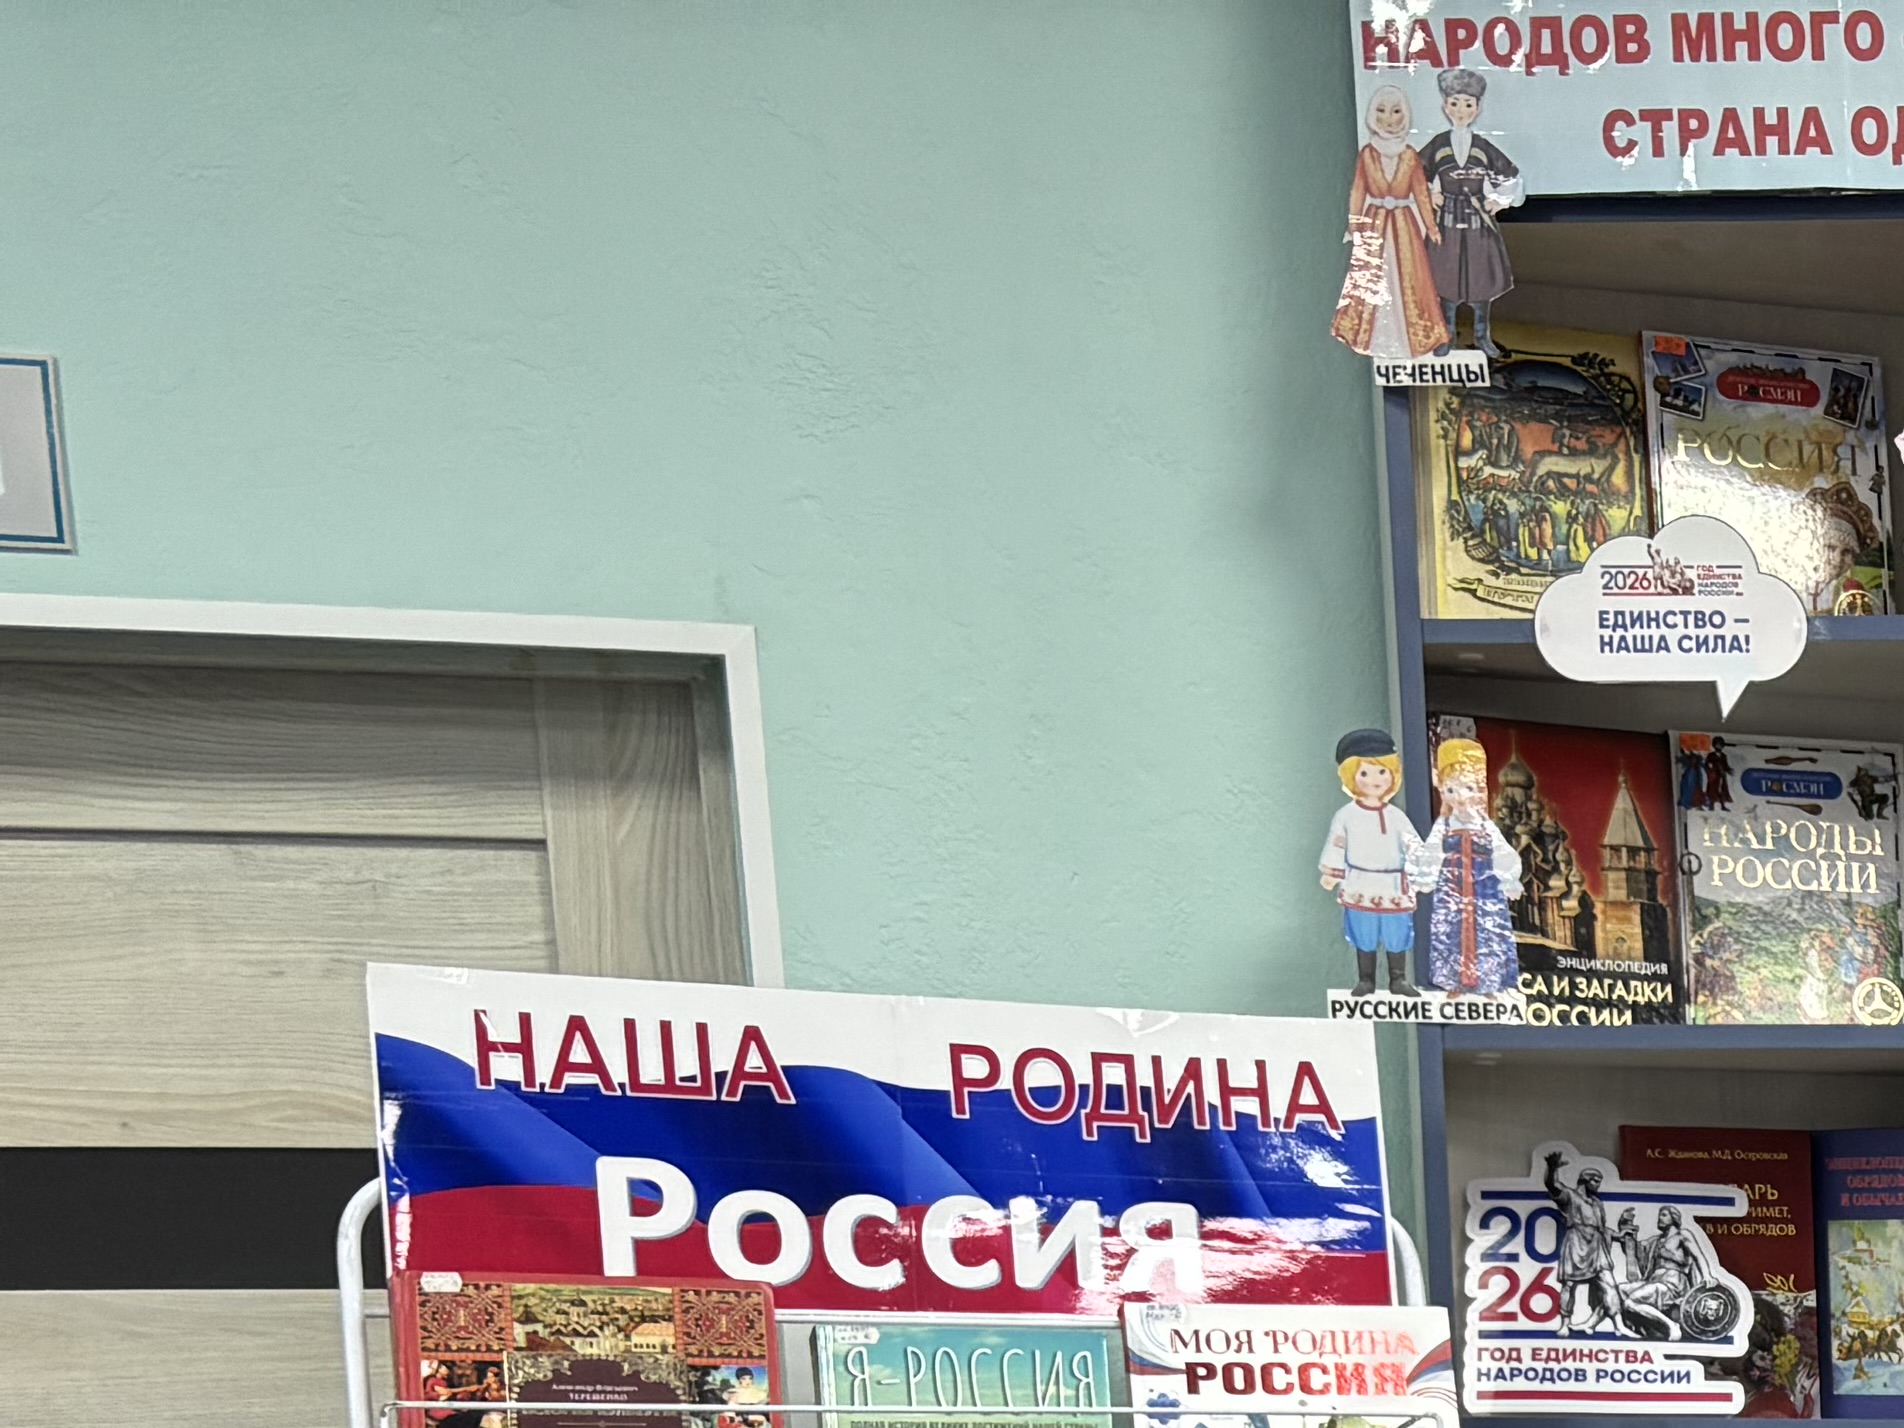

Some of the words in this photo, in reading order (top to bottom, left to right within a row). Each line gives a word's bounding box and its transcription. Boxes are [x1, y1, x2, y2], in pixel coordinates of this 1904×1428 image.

[1361, 14, 1652, 75] НАРОДОВ
[1673, 11, 1884, 63] МНОГО
[1602, 107, 1833, 159] СТРАНА
[1376, 364, 1488, 386] ЧЕЧЕНЦЫ
[1601, 570, 1650, 590] 2026
[1599, 610, 1726, 630] ЕДИНСТВО
[1600, 634, 1670, 653] НАША
[1678, 634, 1750, 653] СИЛА!
[1703, 819, 1885, 861] НАРОДЫ
[1710, 853, 1881, 894] РОССИИ
[1557, 955, 1668, 976] ЭНЦИКЛОПЕДИЯ
[1575, 976, 1672, 1003] ЗАГАДКИ
[1331, 1000, 1433, 1023] РУССКИЕ
[1439, 1000, 1523, 1022] СЕВЕРА
[475, 1010, 797, 1105] НАША
[949, 1042, 1344, 1142] РОДИНА
[595, 1154, 1203, 1292] Россия
[1479, 1207, 1564, 1263] 20
[1732, 1222, 1796, 1237] ОБРЯДОВ
[1478, 1266, 1561, 1322] 26
[1170, 1328, 1255, 1354] МОЯ
[1264, 1329, 1420, 1358] РОДИНА
[1478, 1348, 1522, 1365] ГОД
[1531, 1348, 1654, 1365] ЕДИНСТВА
[1185, 1362, 1408, 1396] РОССИЯ
[1476, 1367, 1588, 1384] НАРОДОВ
[1596, 1369, 1690, 1384] РОССИИ
